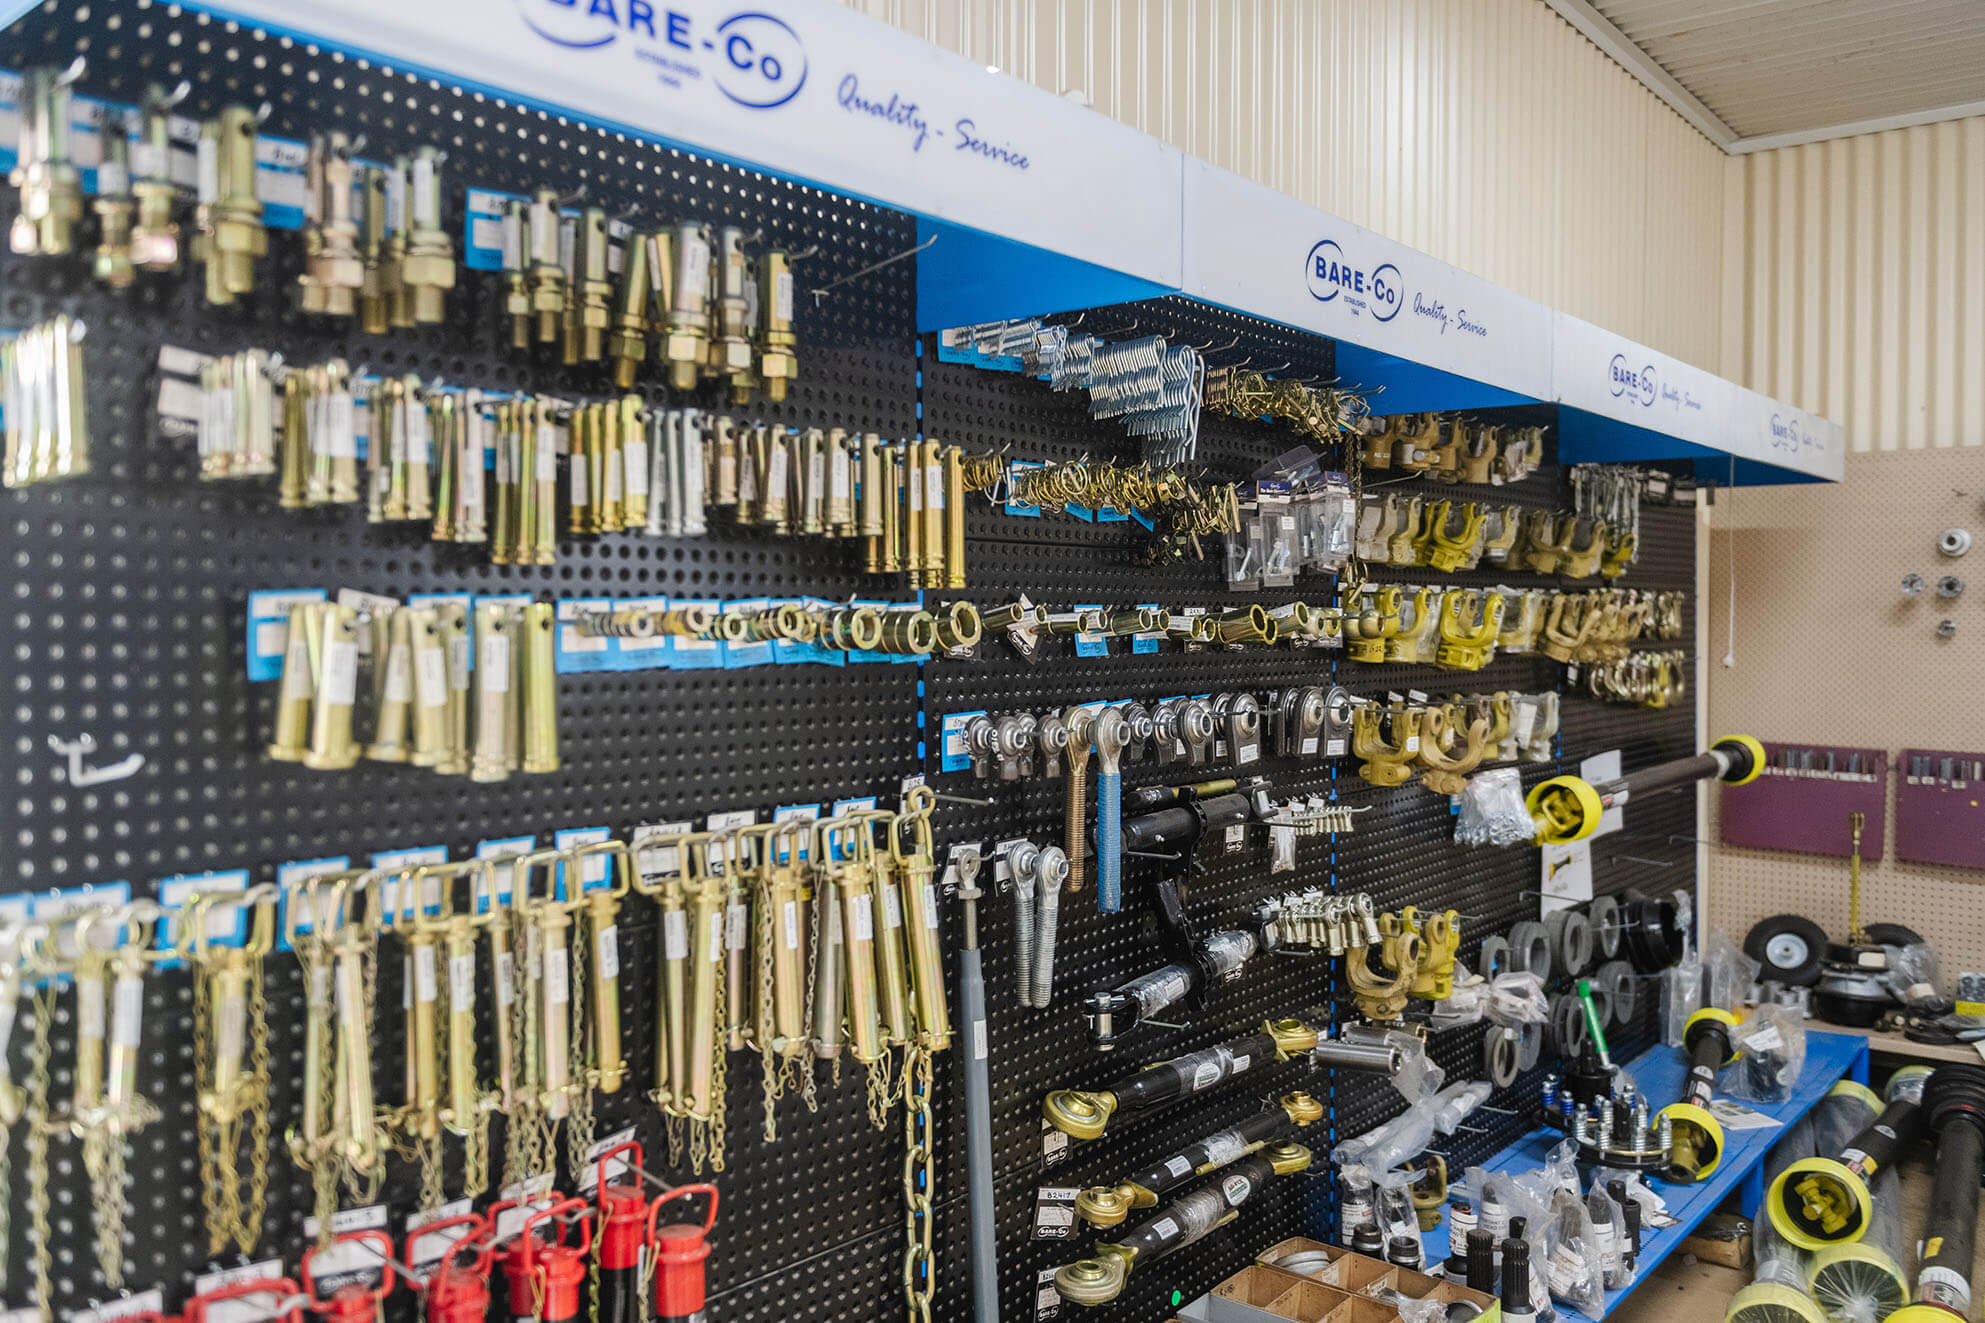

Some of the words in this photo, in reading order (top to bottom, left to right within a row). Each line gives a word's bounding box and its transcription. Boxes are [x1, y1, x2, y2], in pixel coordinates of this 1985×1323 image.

[837, 73, 928, 153] Quality
[955, 118, 1030, 170] Service
[1316, 255, 1395, 304] BARE-Co
[1413, 292, 1447, 335] Quality
[1457, 309, 1488, 337] Service
[1613, 365, 1653, 394] BARE-Co
